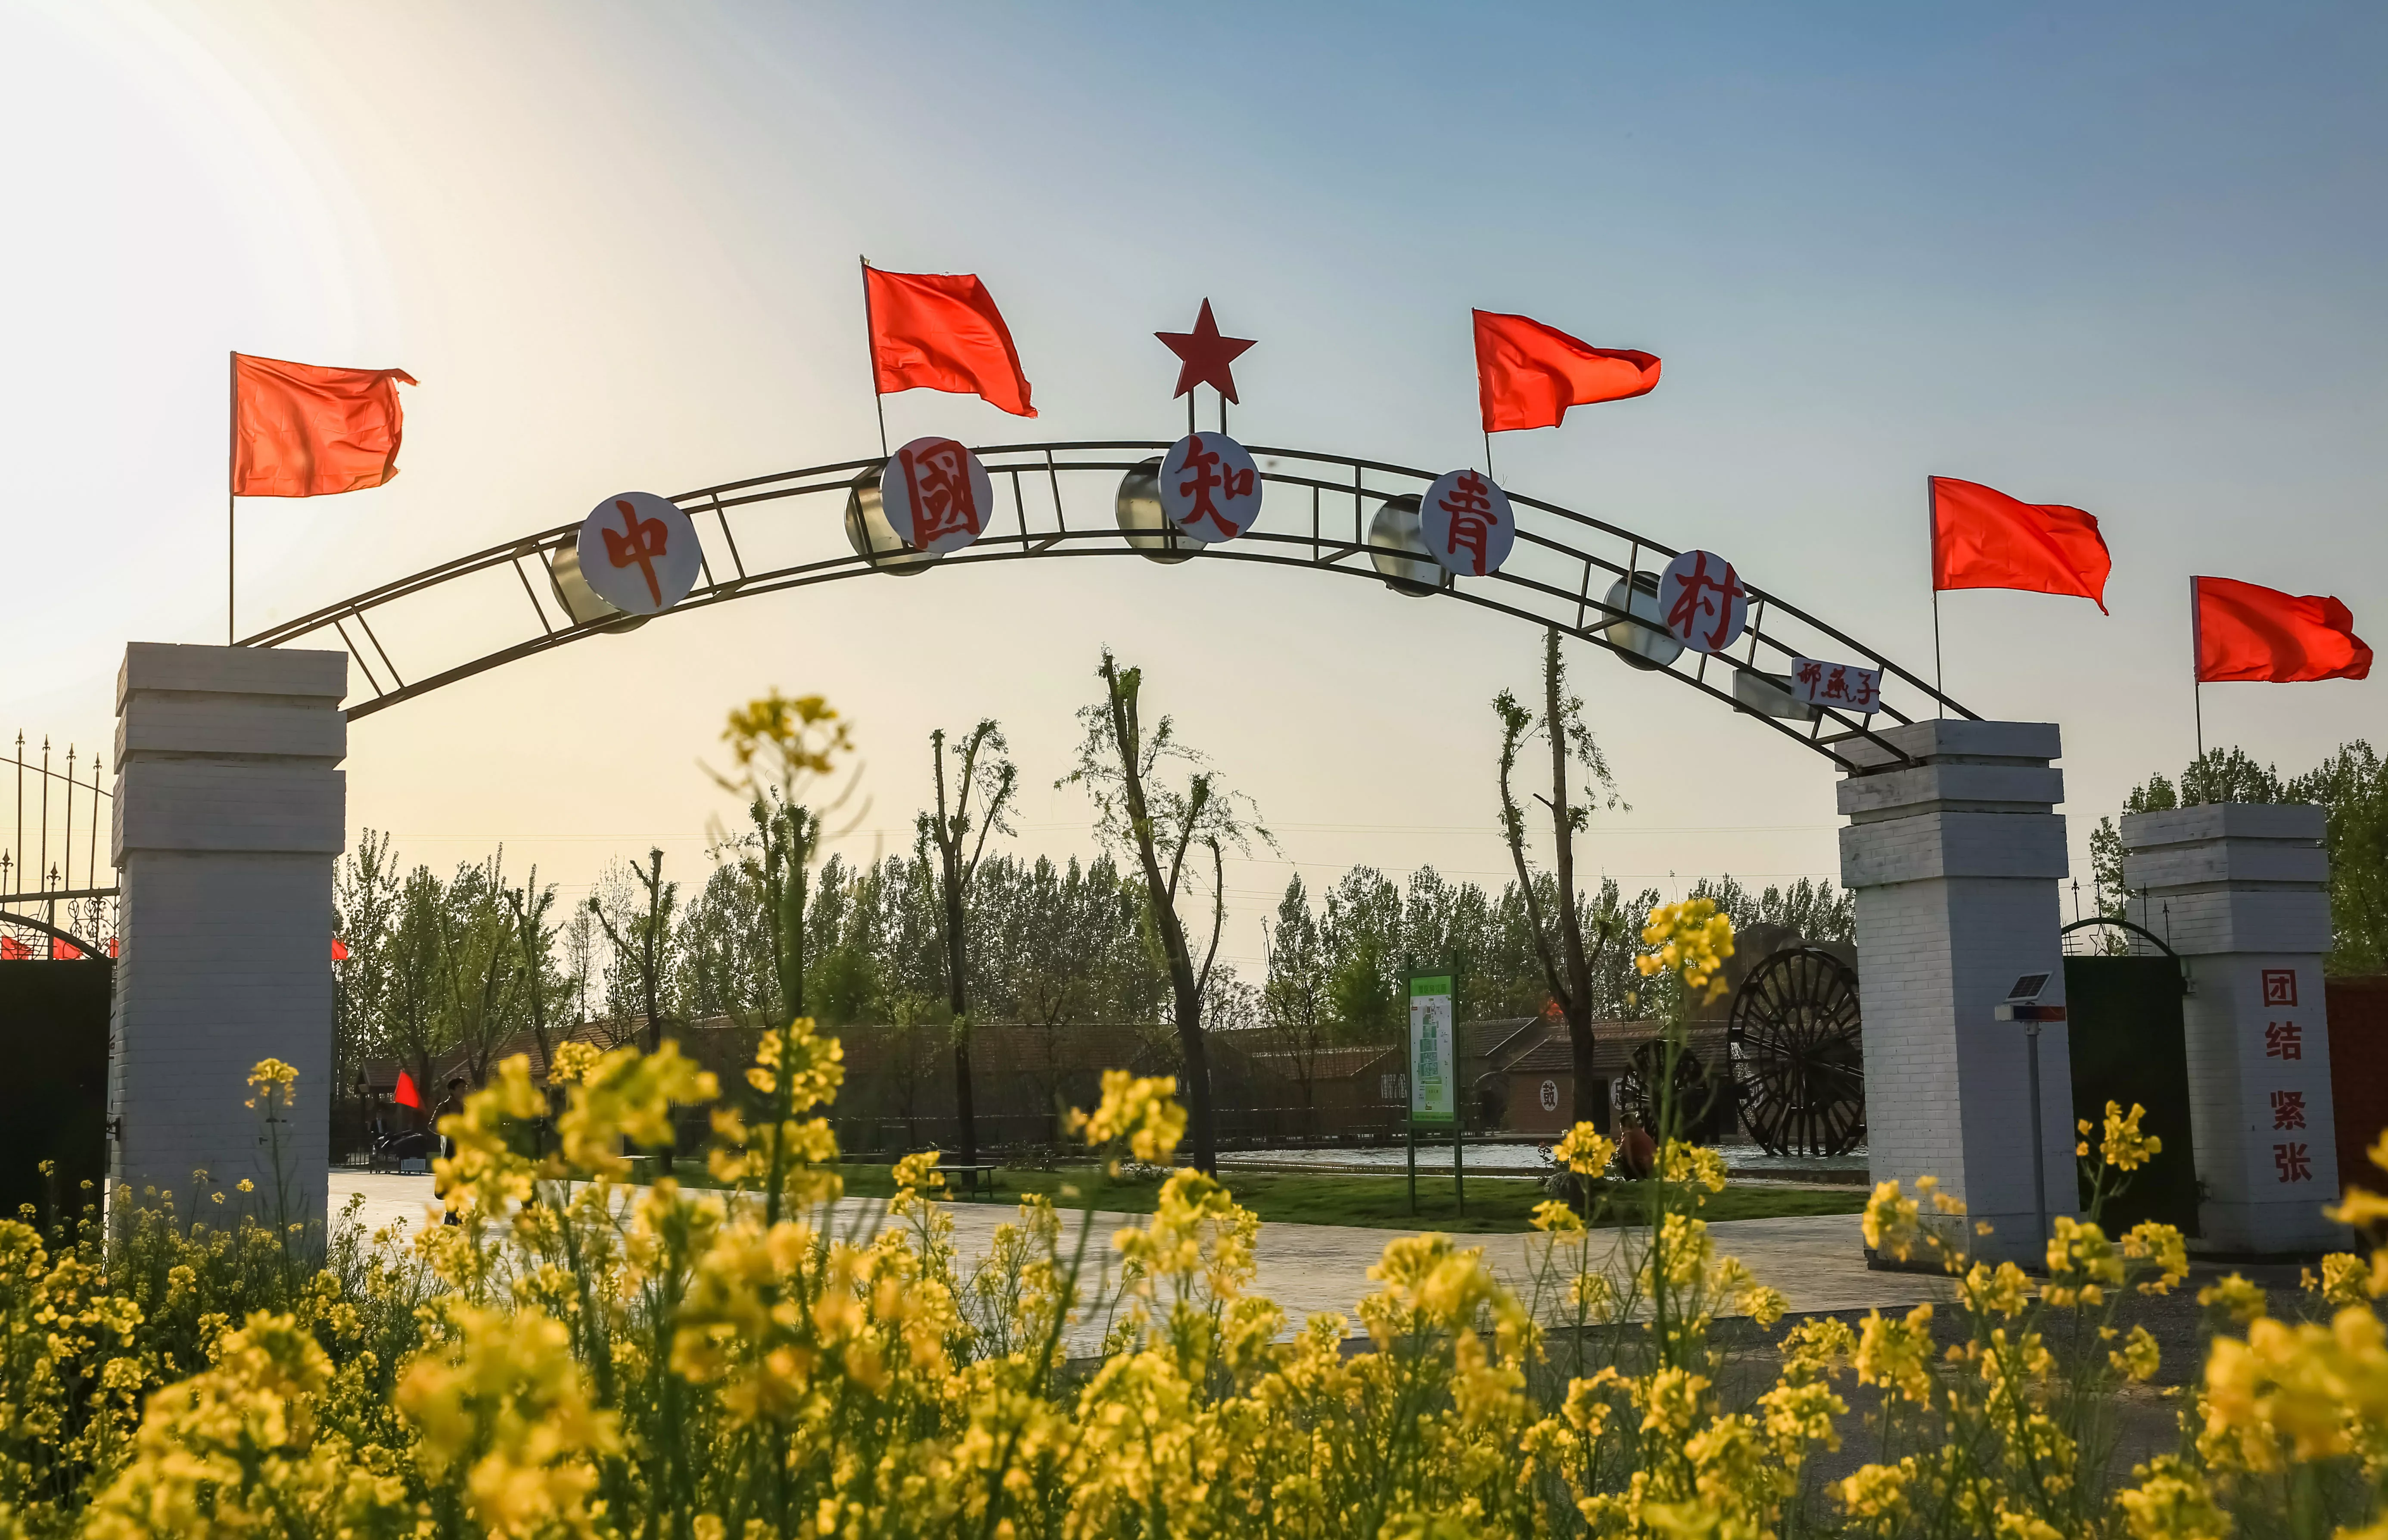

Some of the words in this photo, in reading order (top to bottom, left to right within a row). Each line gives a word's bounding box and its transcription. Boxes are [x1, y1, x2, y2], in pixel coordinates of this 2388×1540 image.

[602, 500, 668, 608] 中
[899, 440, 980, 550] 國
[1175, 434, 1254, 538] 知
[1439, 468, 1498, 577] 青
[1667, 550, 1744, 650] 村
[2261, 969, 2302, 1060] 团结
[2270, 1090, 2313, 1183] 紧张
